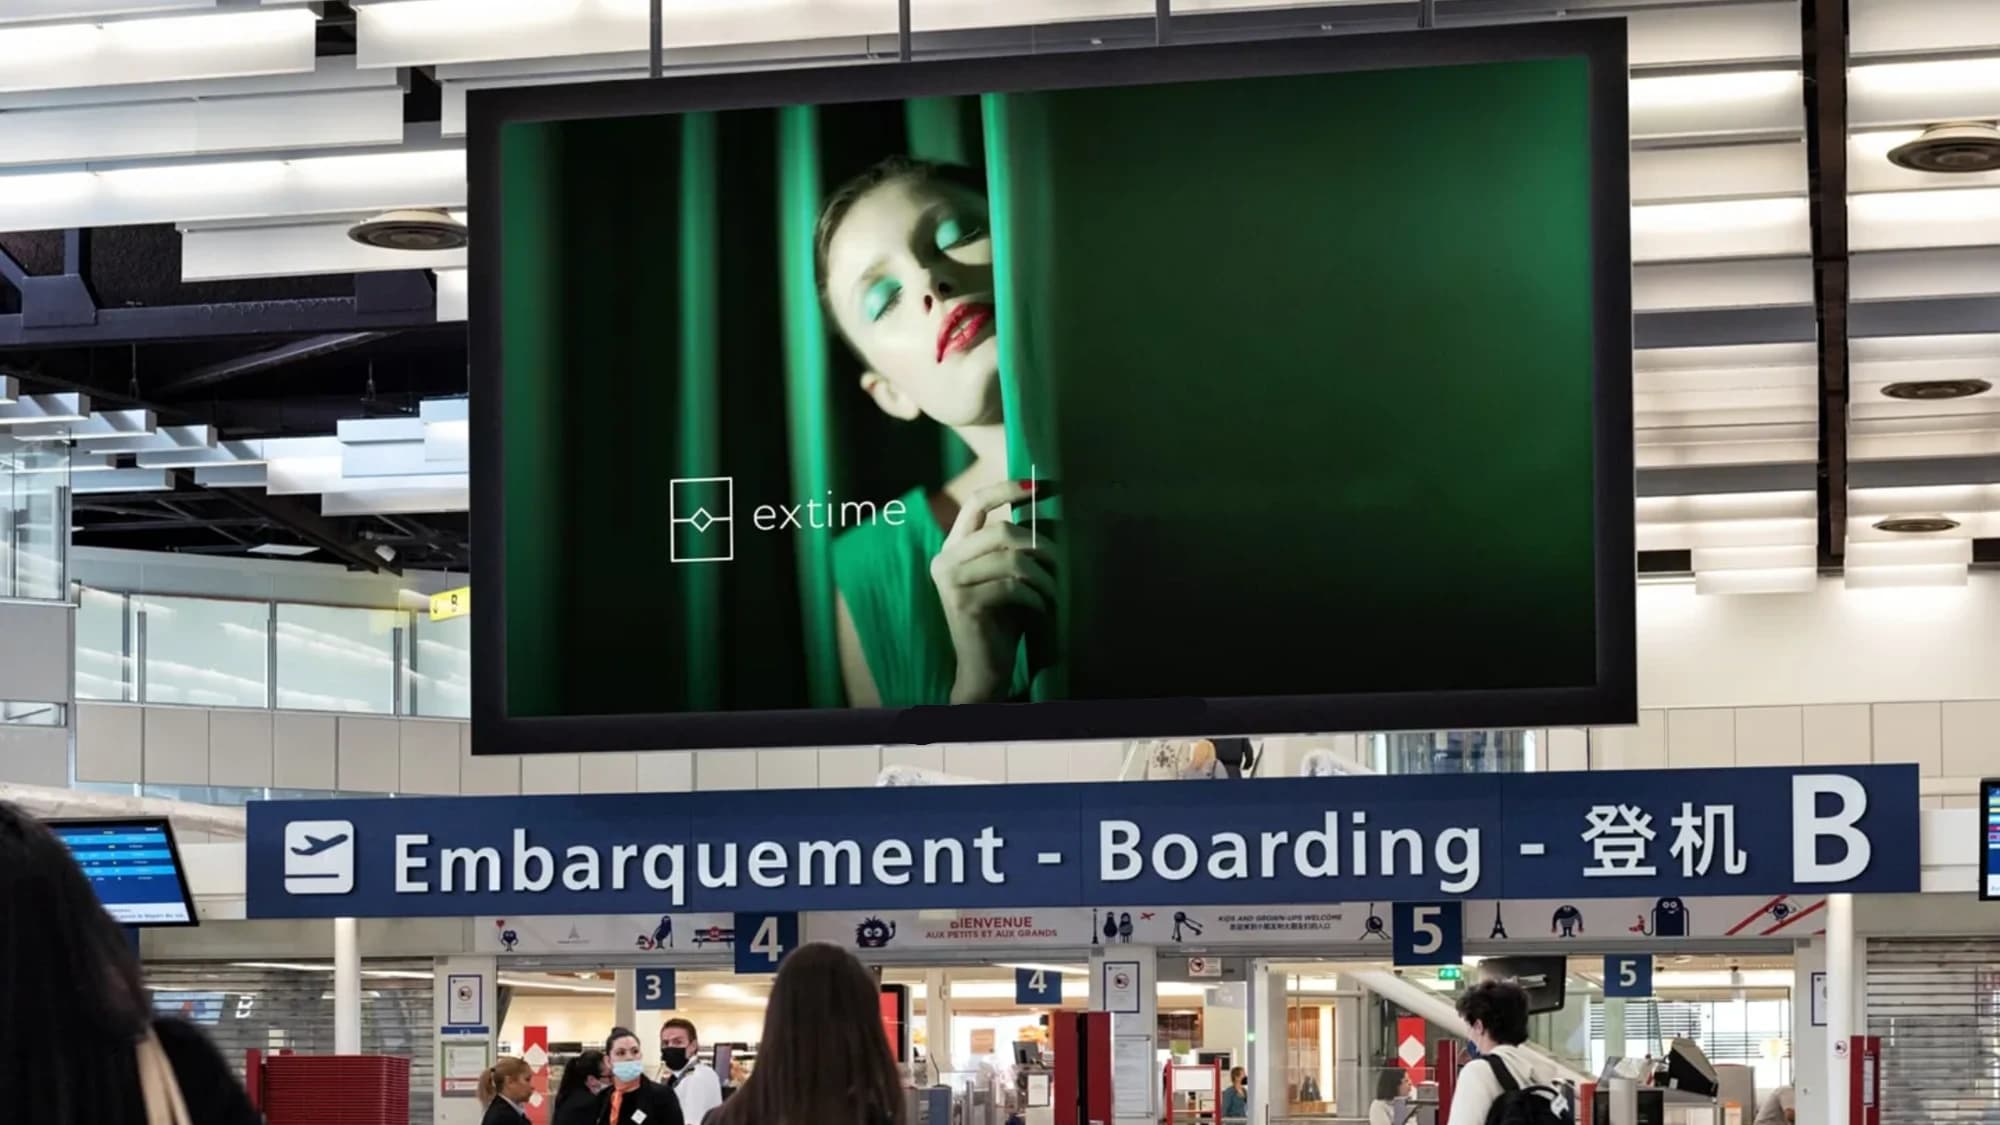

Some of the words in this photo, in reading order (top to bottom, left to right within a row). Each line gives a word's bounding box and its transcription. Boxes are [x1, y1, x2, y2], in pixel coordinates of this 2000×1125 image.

[754, 490, 906, 531] extime
[395, 826, 1005, 906] Embarquement
[1100, 811, 1480, 893] Boarding
[1582, 802, 1747, 877] 登机
[1792, 773, 1871, 883] B
[1304, 913, 1343, 921] WELCOME
[1413, 906, 1442, 954] 5
[750, 917, 783, 962] 4
[926, 930, 945, 939] AUX
[947, 930, 979, 939] PETITS
[981, 930, 993, 938] ET
[996, 929, 1015, 937] AUX
[1017, 928, 1058, 937] GRANDS
[1028, 968, 1047, 994] 4
[1619, 960, 1638, 987] 5
[645, 975, 662, 1000] 3
